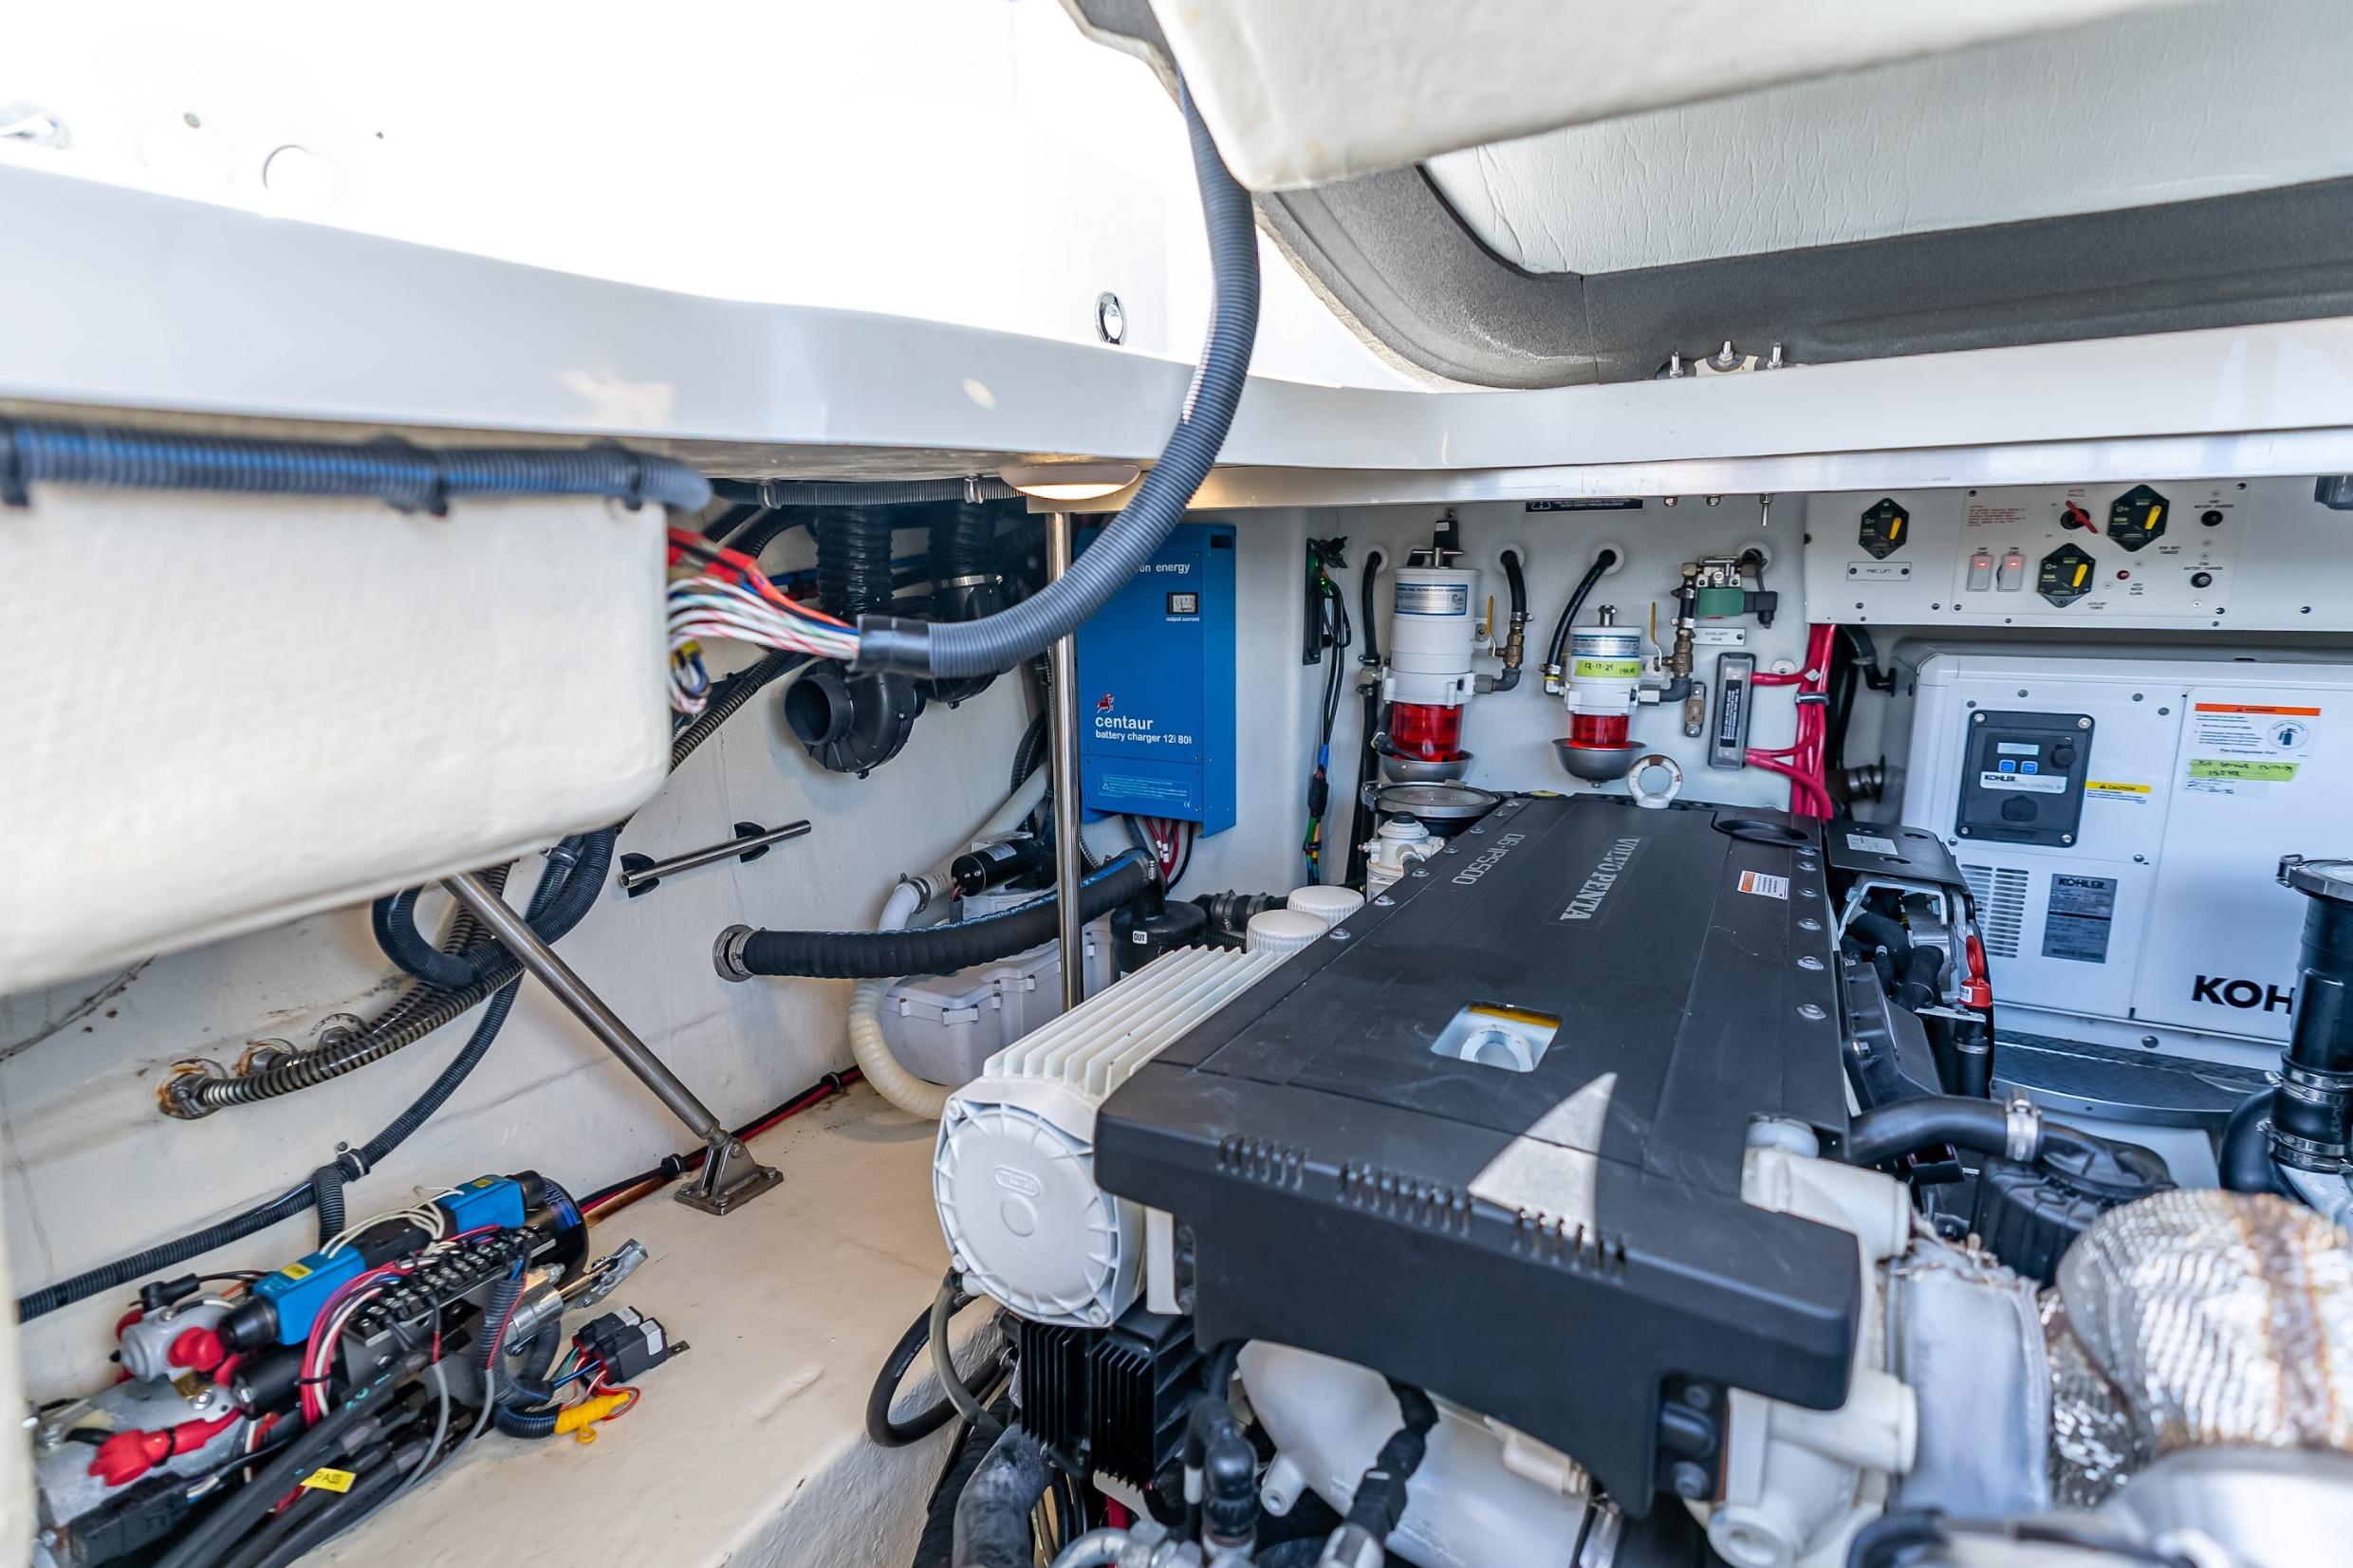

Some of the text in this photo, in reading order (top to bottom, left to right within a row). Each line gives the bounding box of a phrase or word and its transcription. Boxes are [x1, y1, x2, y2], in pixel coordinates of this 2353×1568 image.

[1156, 563, 1191, 574] energy
[1095, 715, 1154, 730] centaur
[1095, 729, 1125, 742] battery
[1127, 732, 1160, 744] charger
[1984, 774, 2017, 783] KOHLER
[1559, 837, 1641, 921] VOLVO PENTA
[2058, 877, 2106, 890] KOHLER
[1133, 932, 1145, 942] OUT
[2191, 974, 2296, 1015] KOH
